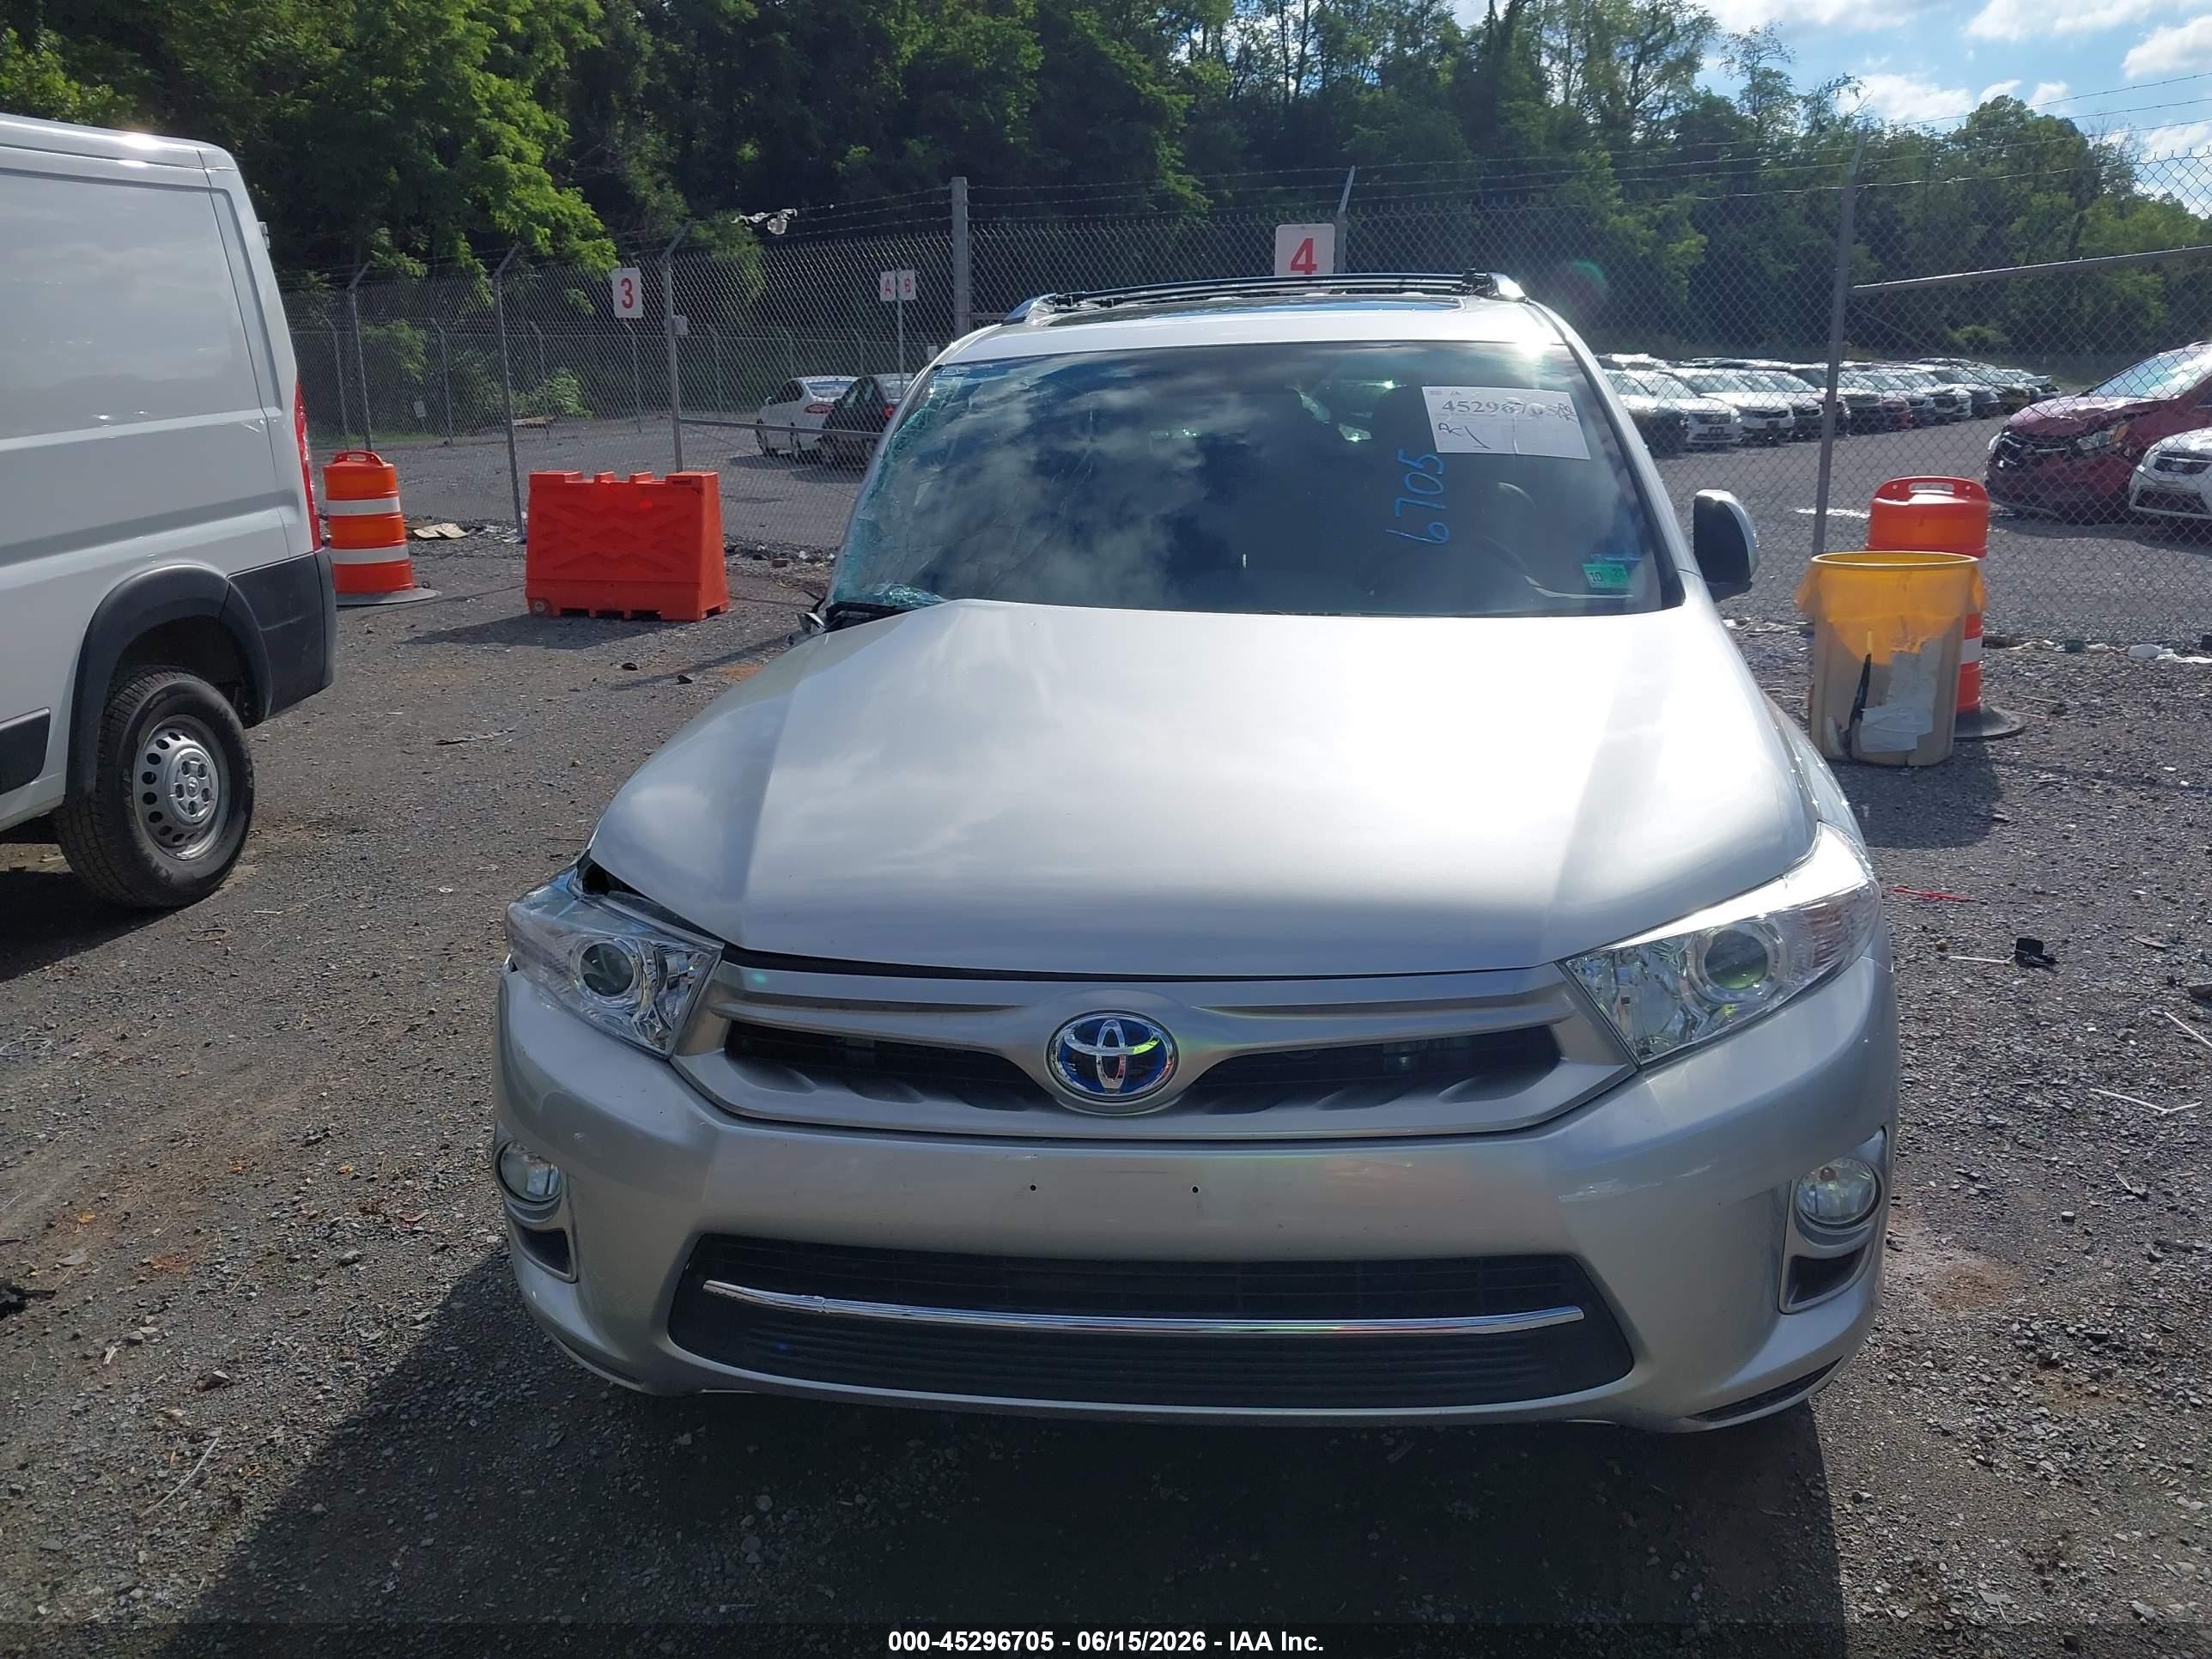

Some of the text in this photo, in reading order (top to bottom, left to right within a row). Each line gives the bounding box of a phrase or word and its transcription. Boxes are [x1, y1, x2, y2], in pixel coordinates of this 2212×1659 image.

[1290, 237, 1318, 276] 4
[620, 277, 634, 309] 3
[1384, 448, 1449, 544] 6705
